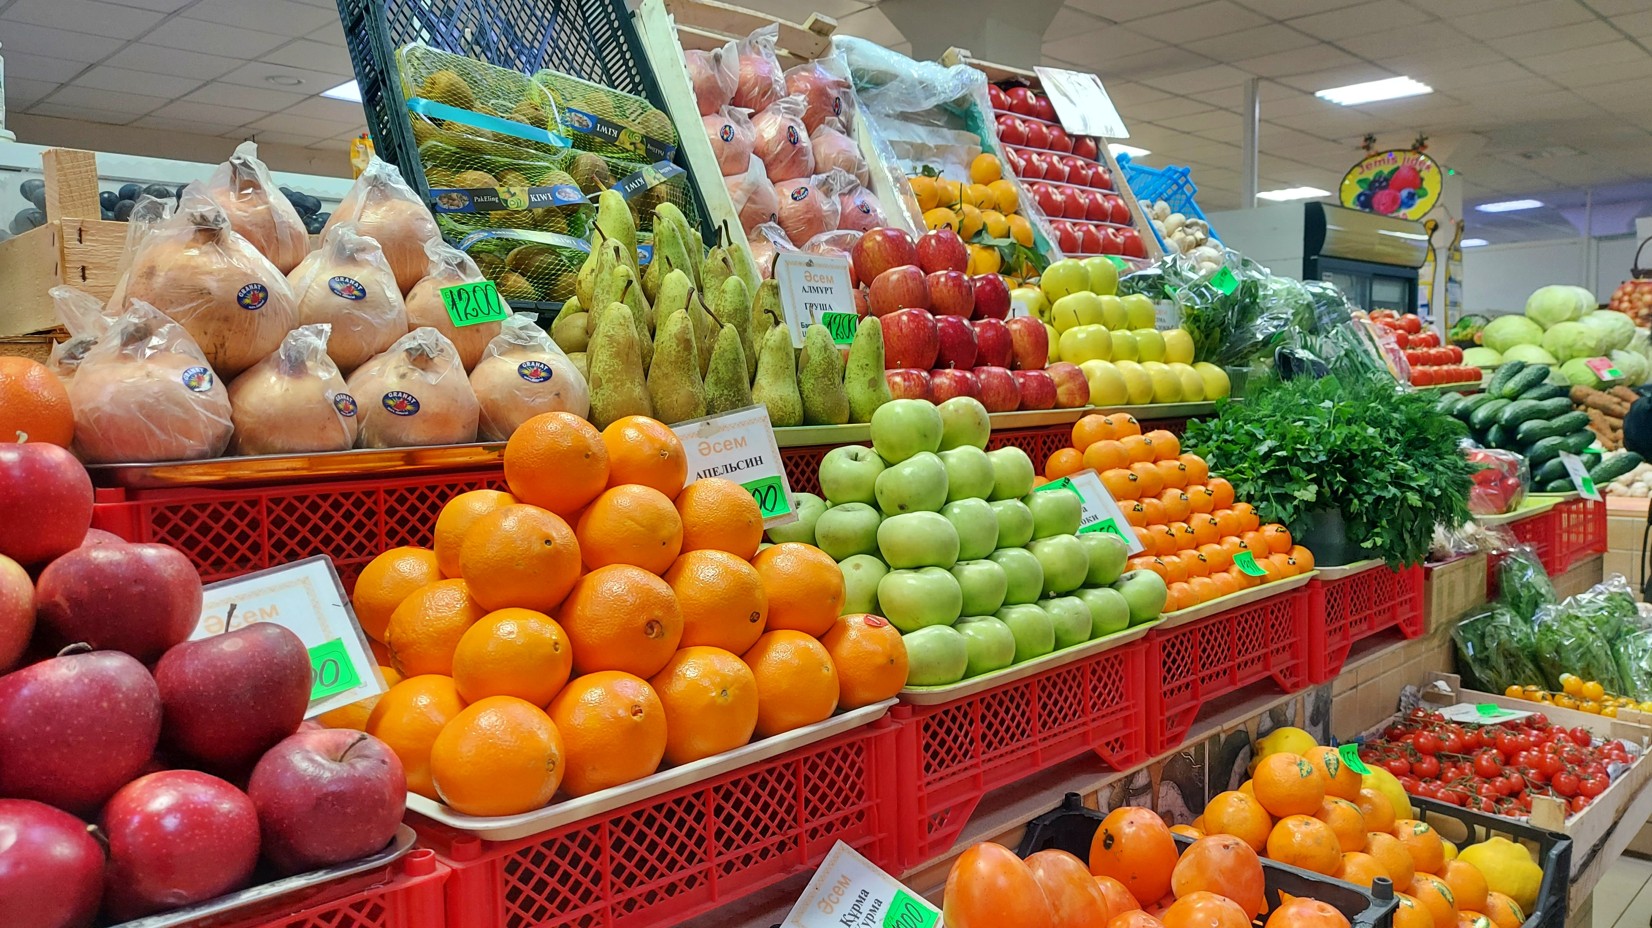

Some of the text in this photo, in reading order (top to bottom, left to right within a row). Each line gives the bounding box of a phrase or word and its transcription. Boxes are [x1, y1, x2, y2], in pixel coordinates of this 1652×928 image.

[596, 124, 618, 138] KIWI
[625, 177, 645, 193] KIWI
[530, 193, 553, 202] KIWI
[334, 276, 363, 290] GRANAT
[804, 270, 834, 284] Әсем
[238, 284, 261, 298] GRANAT
[450, 284, 501, 321] 1200
[804, 303, 833, 311] ГРУША
[826, 314, 858, 340] 1200
[522, 361, 548, 371] GRANAT
[388, 392, 416, 403] GRANAT
[698, 436, 747, 457] Әсем
[695, 456, 764, 481] АПЕЛЬСИН
[205, 604, 279, 634] Әсем
[817, 874, 851, 915] Әсем
